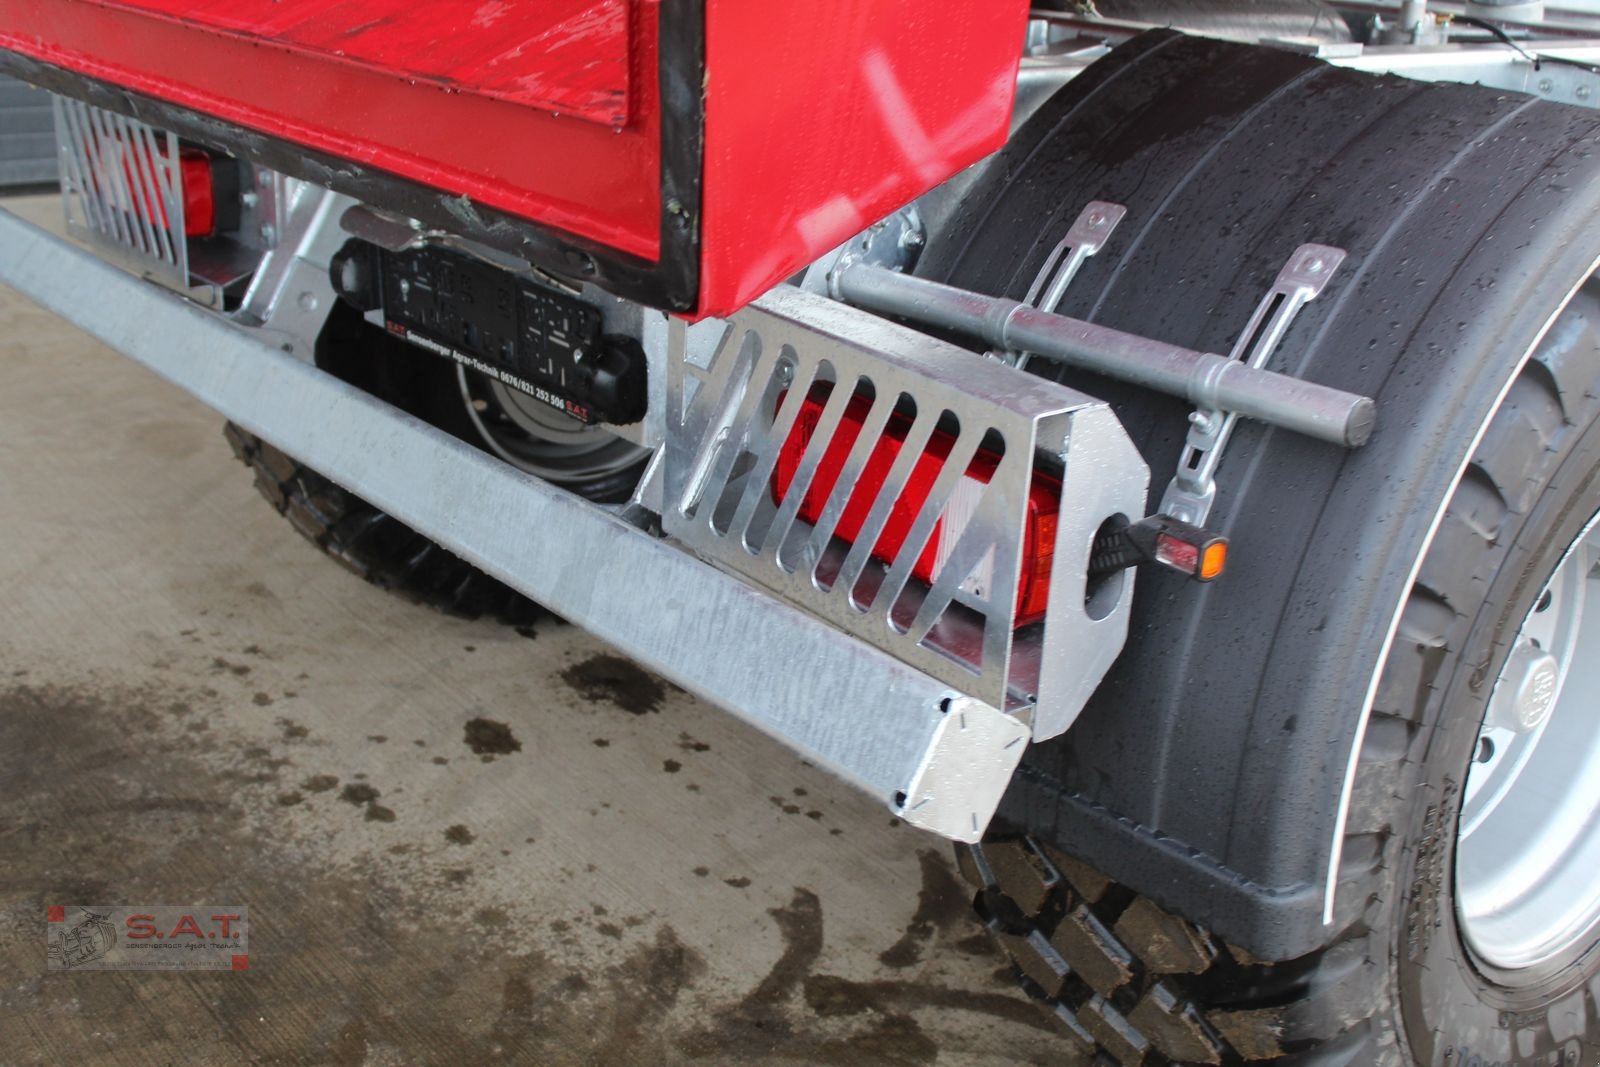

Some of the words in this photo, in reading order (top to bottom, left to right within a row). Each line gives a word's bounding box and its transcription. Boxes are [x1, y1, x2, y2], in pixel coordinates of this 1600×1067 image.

[452, 350, 499, 379] Agrar-Technik
[500, 371, 535, 396] 0676/821
[535, 387, 550, 402] 252
[550, 394, 564, 409] 506
